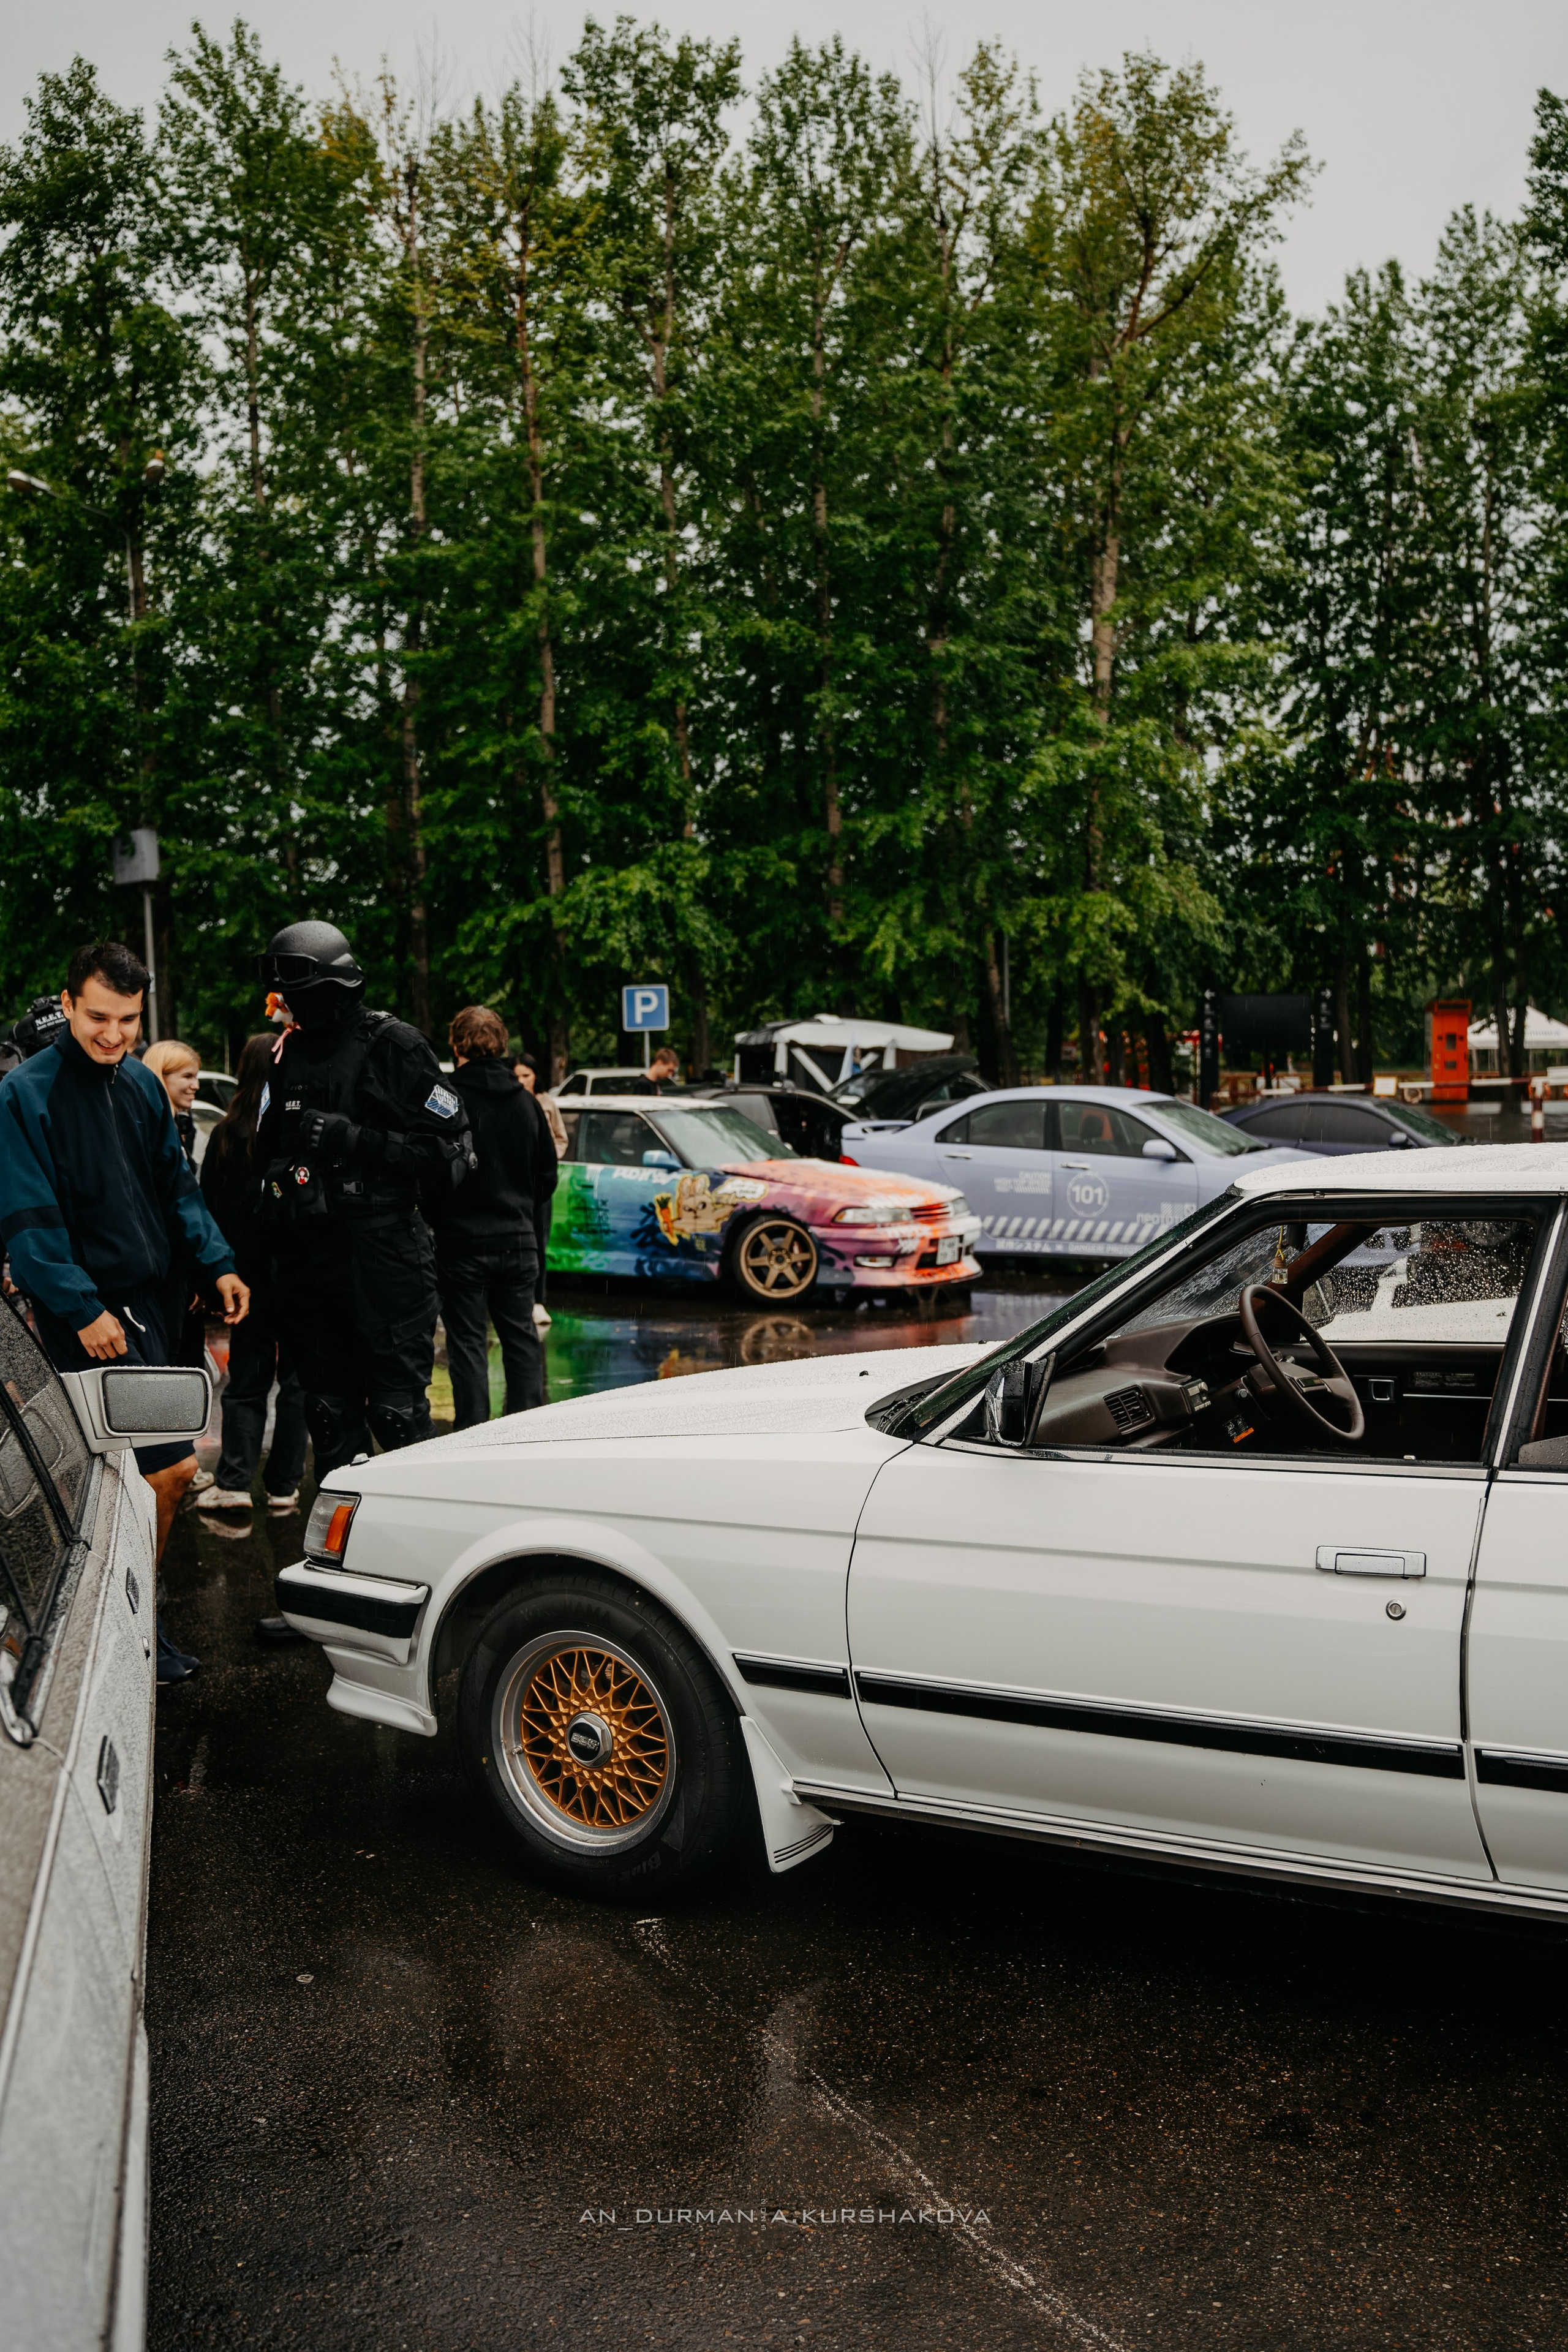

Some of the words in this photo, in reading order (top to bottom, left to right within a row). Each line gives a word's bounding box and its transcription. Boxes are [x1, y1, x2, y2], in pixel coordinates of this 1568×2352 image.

[634, 990, 658, 1024] P
[1019, 1170, 1050, 1180] CAUTION
[1072, 1185, 1103, 1205] 101
[570, 1732, 598, 1750] BBS
